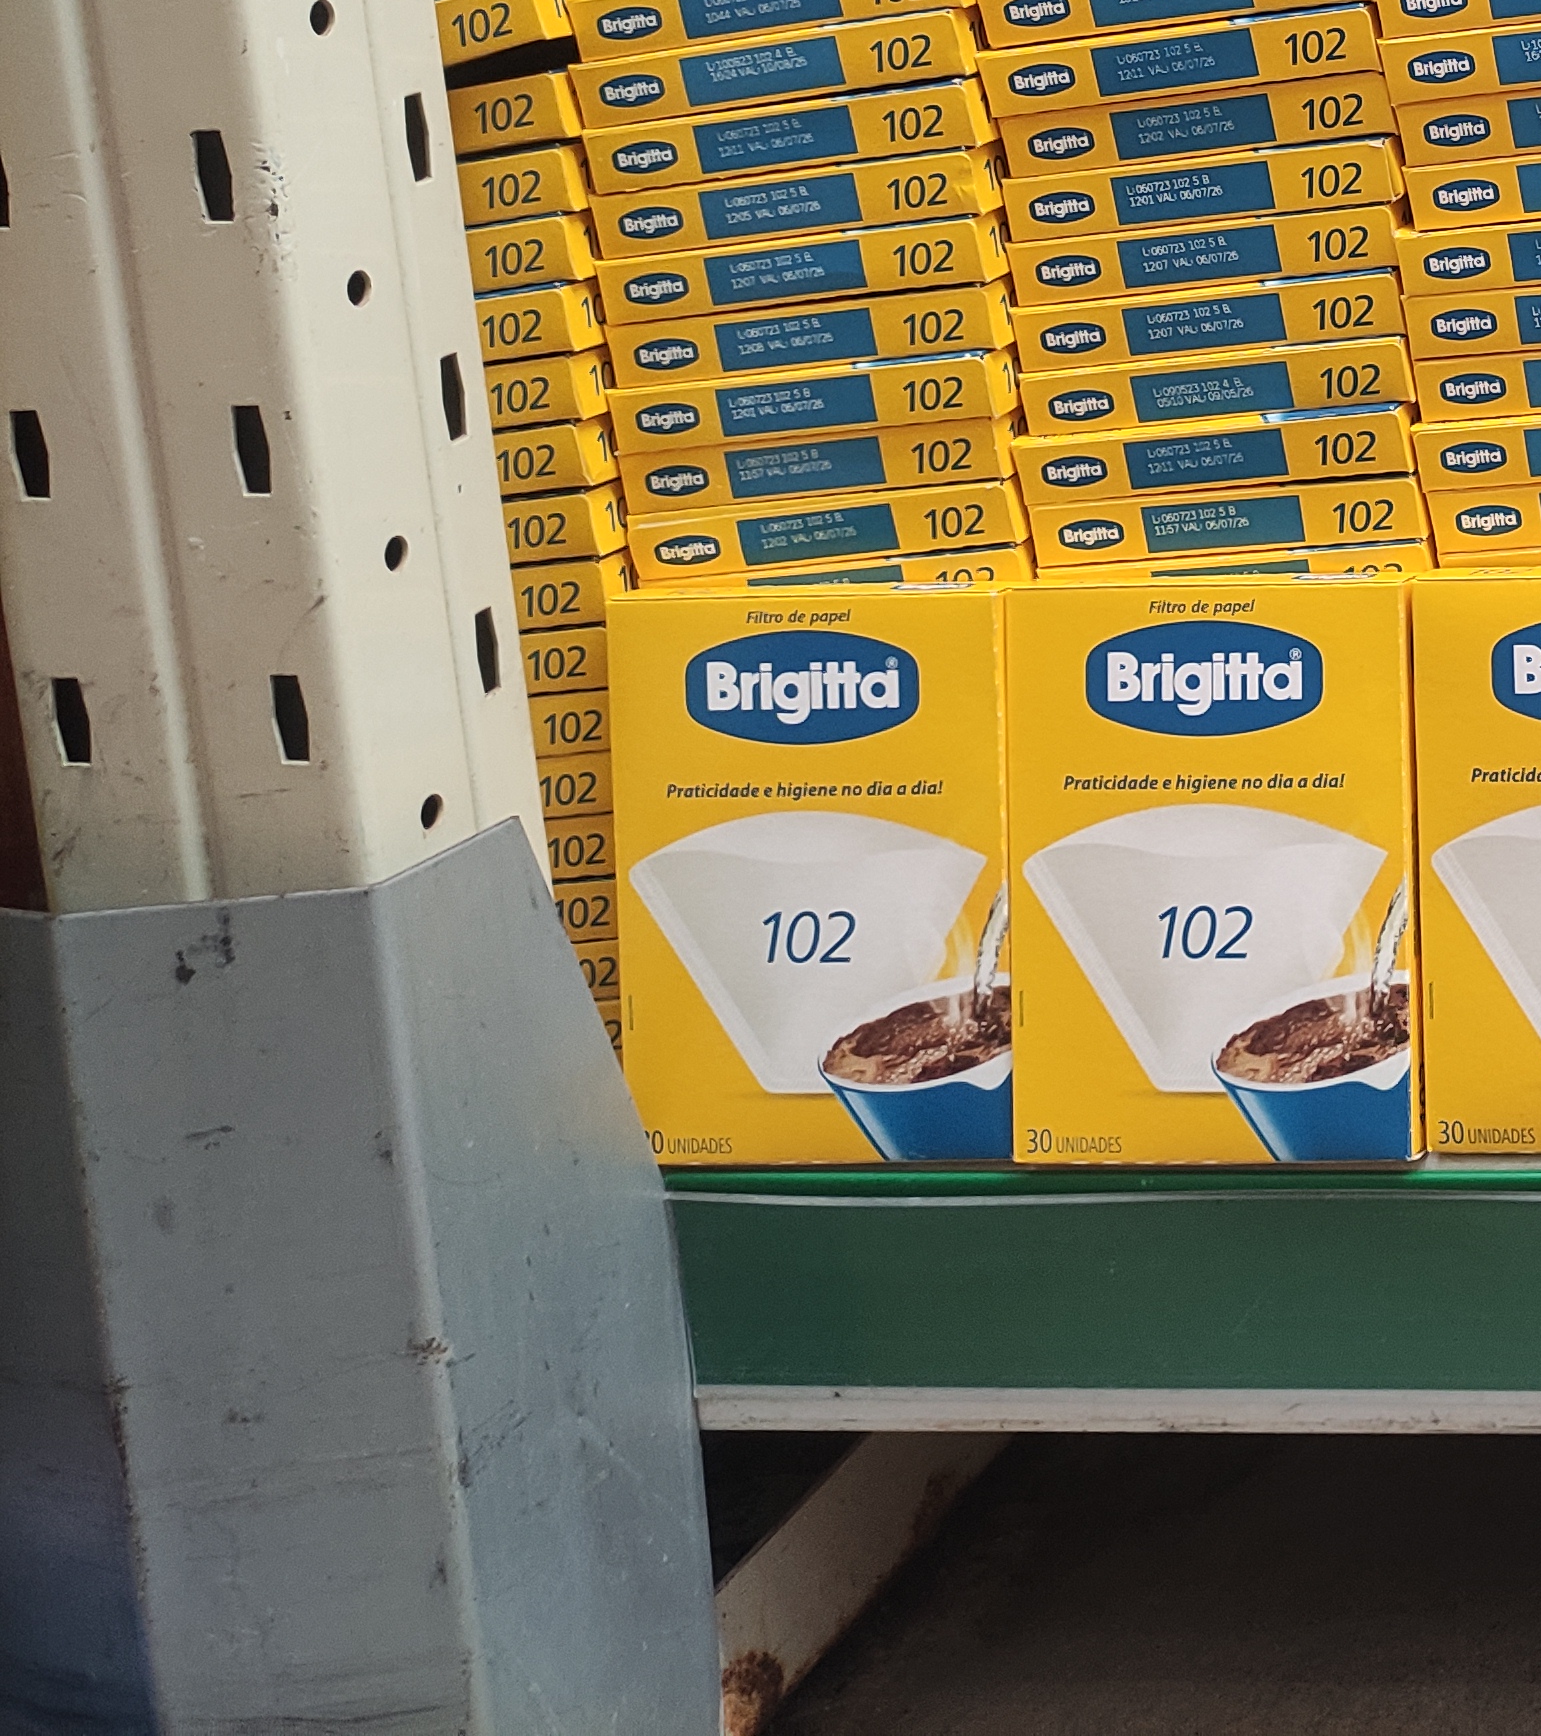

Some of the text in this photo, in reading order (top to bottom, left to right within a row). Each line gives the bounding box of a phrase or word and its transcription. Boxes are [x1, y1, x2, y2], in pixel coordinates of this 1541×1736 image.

[521, 584, 581, 615] 102
[706, 658, 900, 726] Brigitta
[1106, 651, 1302, 717] Brigitta
[761, 910, 857, 964] 102
[1157, 906, 1253, 960] 102
[1026, 1130, 1122, 1155] 30 UNIDADES
